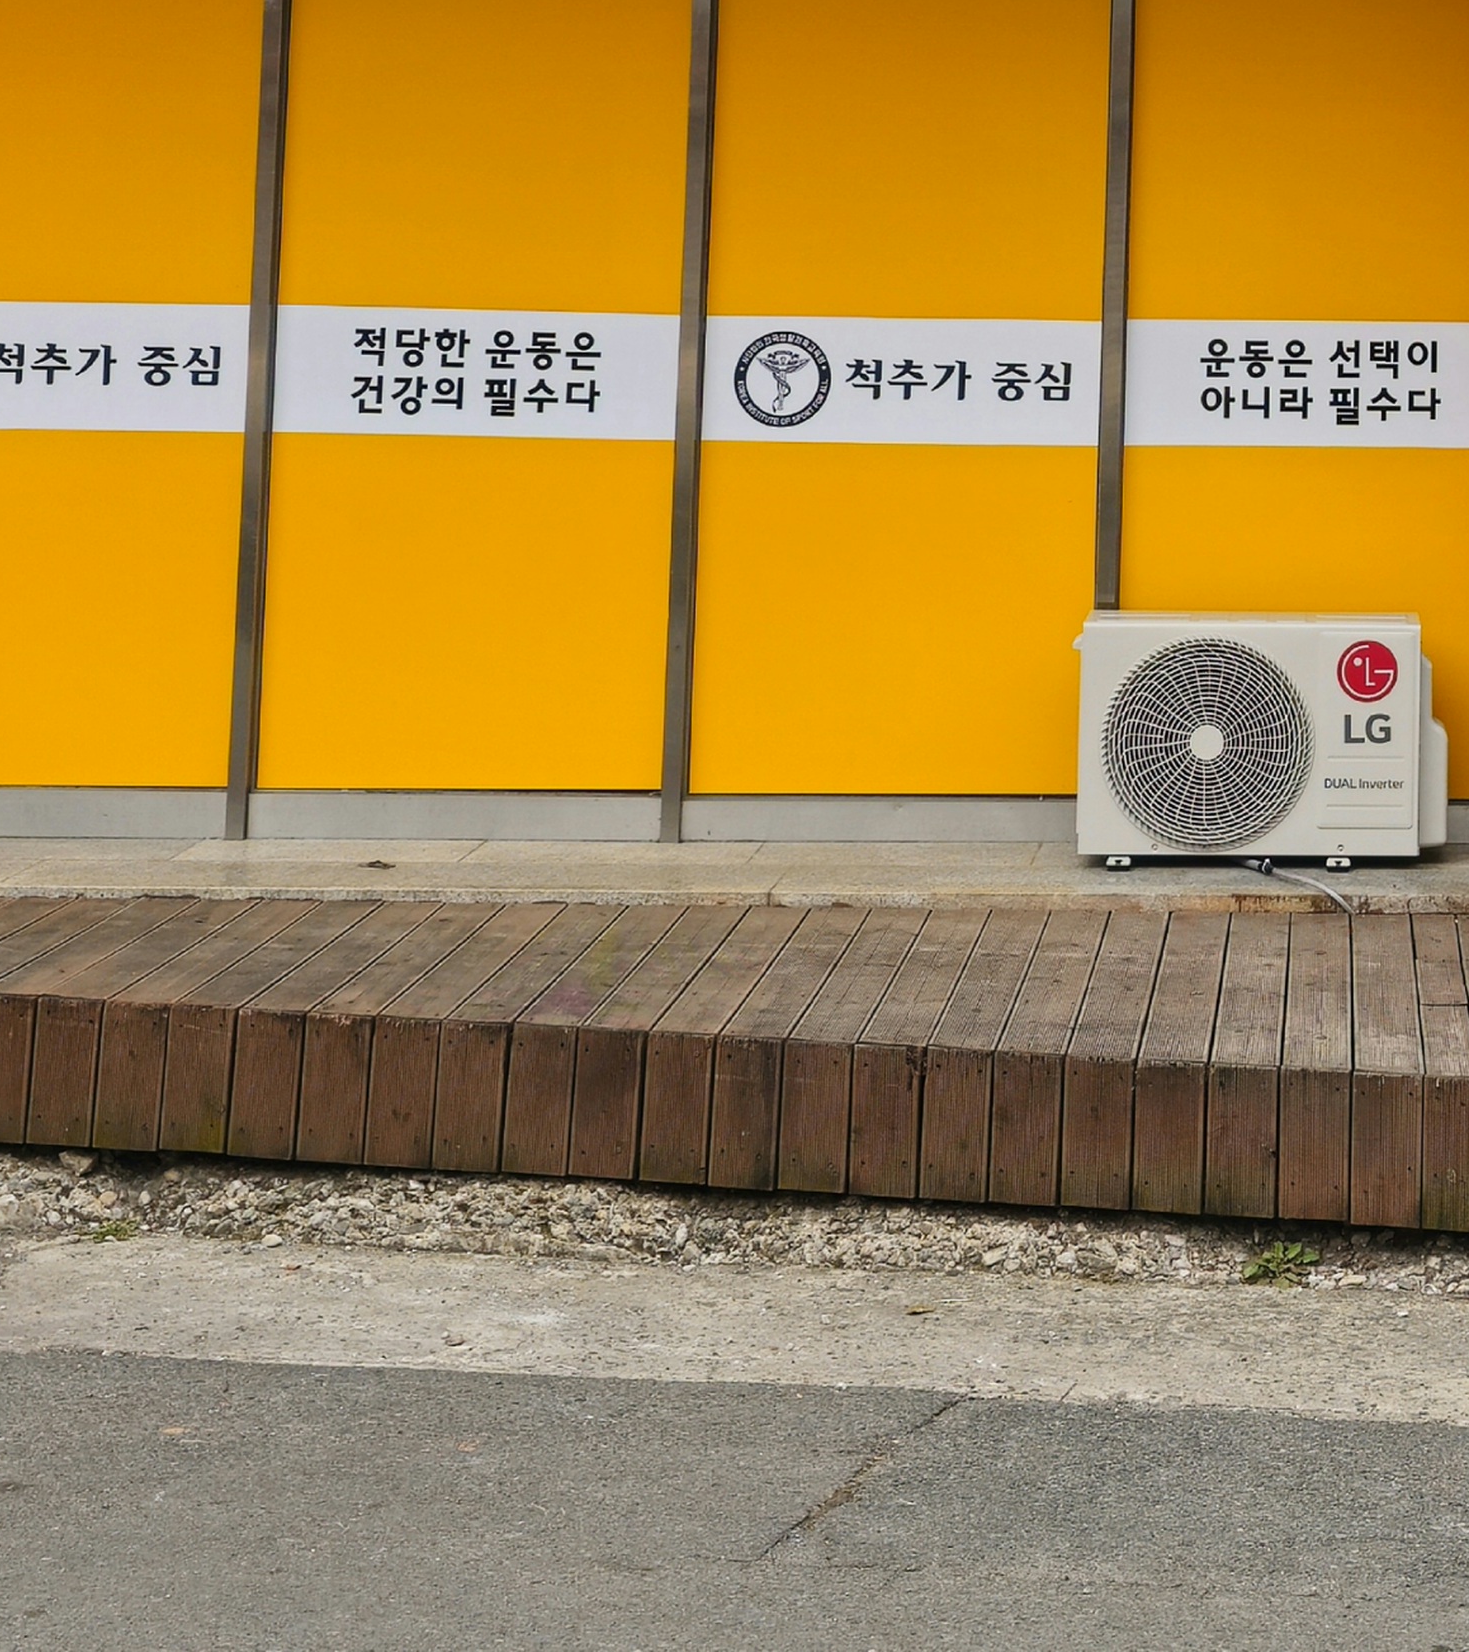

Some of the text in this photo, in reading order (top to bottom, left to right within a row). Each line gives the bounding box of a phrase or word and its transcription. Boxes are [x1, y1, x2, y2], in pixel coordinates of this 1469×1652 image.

[138, 345, 221, 386] 중심
[354, 328, 602, 372] 적당한 운동은
[1201, 339, 1438, 380] 운동은 선택이
[351, 375, 601, 418] 건강의 필수다
[846, 359, 1072, 402] 척추가 중심
[1201, 385, 1441, 426] 아니라 필수다
[1343, 713, 1392, 744] LG
[1324, 777, 1404, 790] DUAL Inverter
